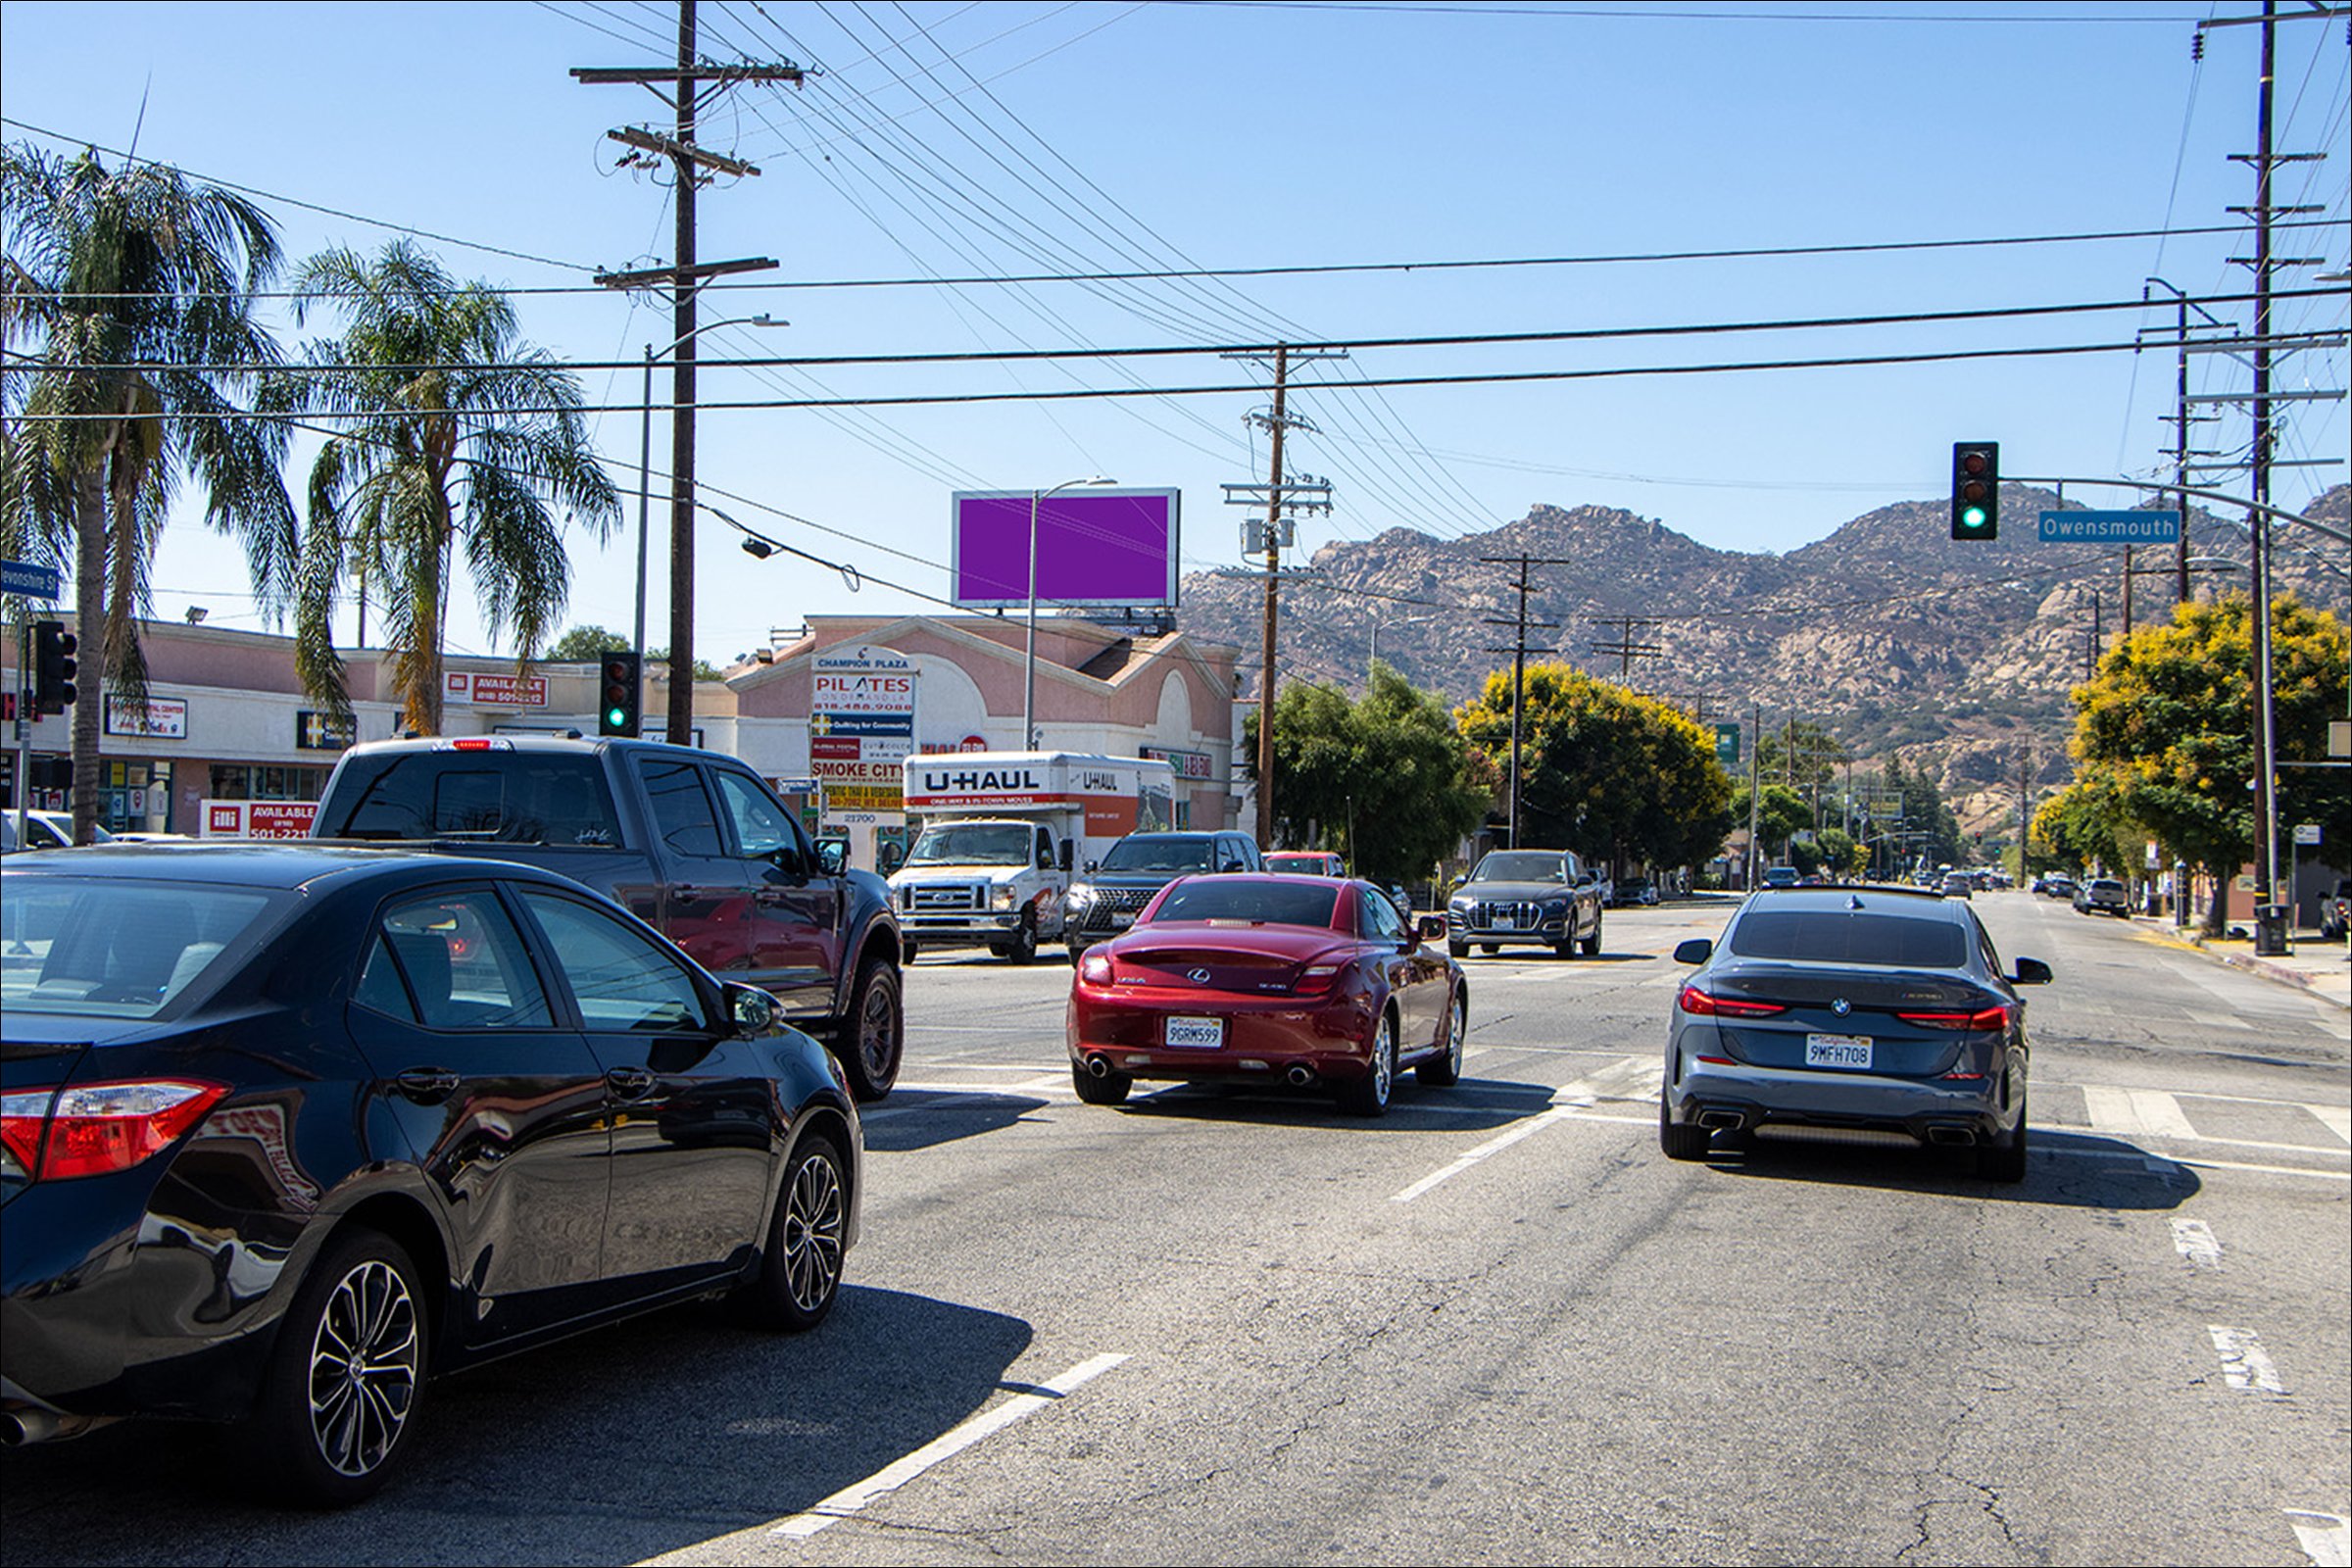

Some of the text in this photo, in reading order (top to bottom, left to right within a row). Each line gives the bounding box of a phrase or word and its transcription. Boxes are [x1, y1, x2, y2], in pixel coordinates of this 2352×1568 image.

[2044, 518, 2174, 535] Owensmouth
[1, 569, 56, 591] evonshire St
[817, 659, 908, 668] CHAMPION PLAZA
[477, 677, 542, 691] AVAILALE
[811, 762, 904, 777] SMOKE CITY
[925, 770, 1040, 791] U-HAUL
[1083, 771, 1118, 792] U-HAUL
[877, 796, 903, 808] DELIVE
[253, 807, 315, 818] AVAILABLE
[844, 813, 876, 823] 21700
[250, 829, 312, 839] 501-221
[1169, 1027, 1219, 1043] 9GRM599
[1810, 1045, 1868, 1064] 9MFH708
